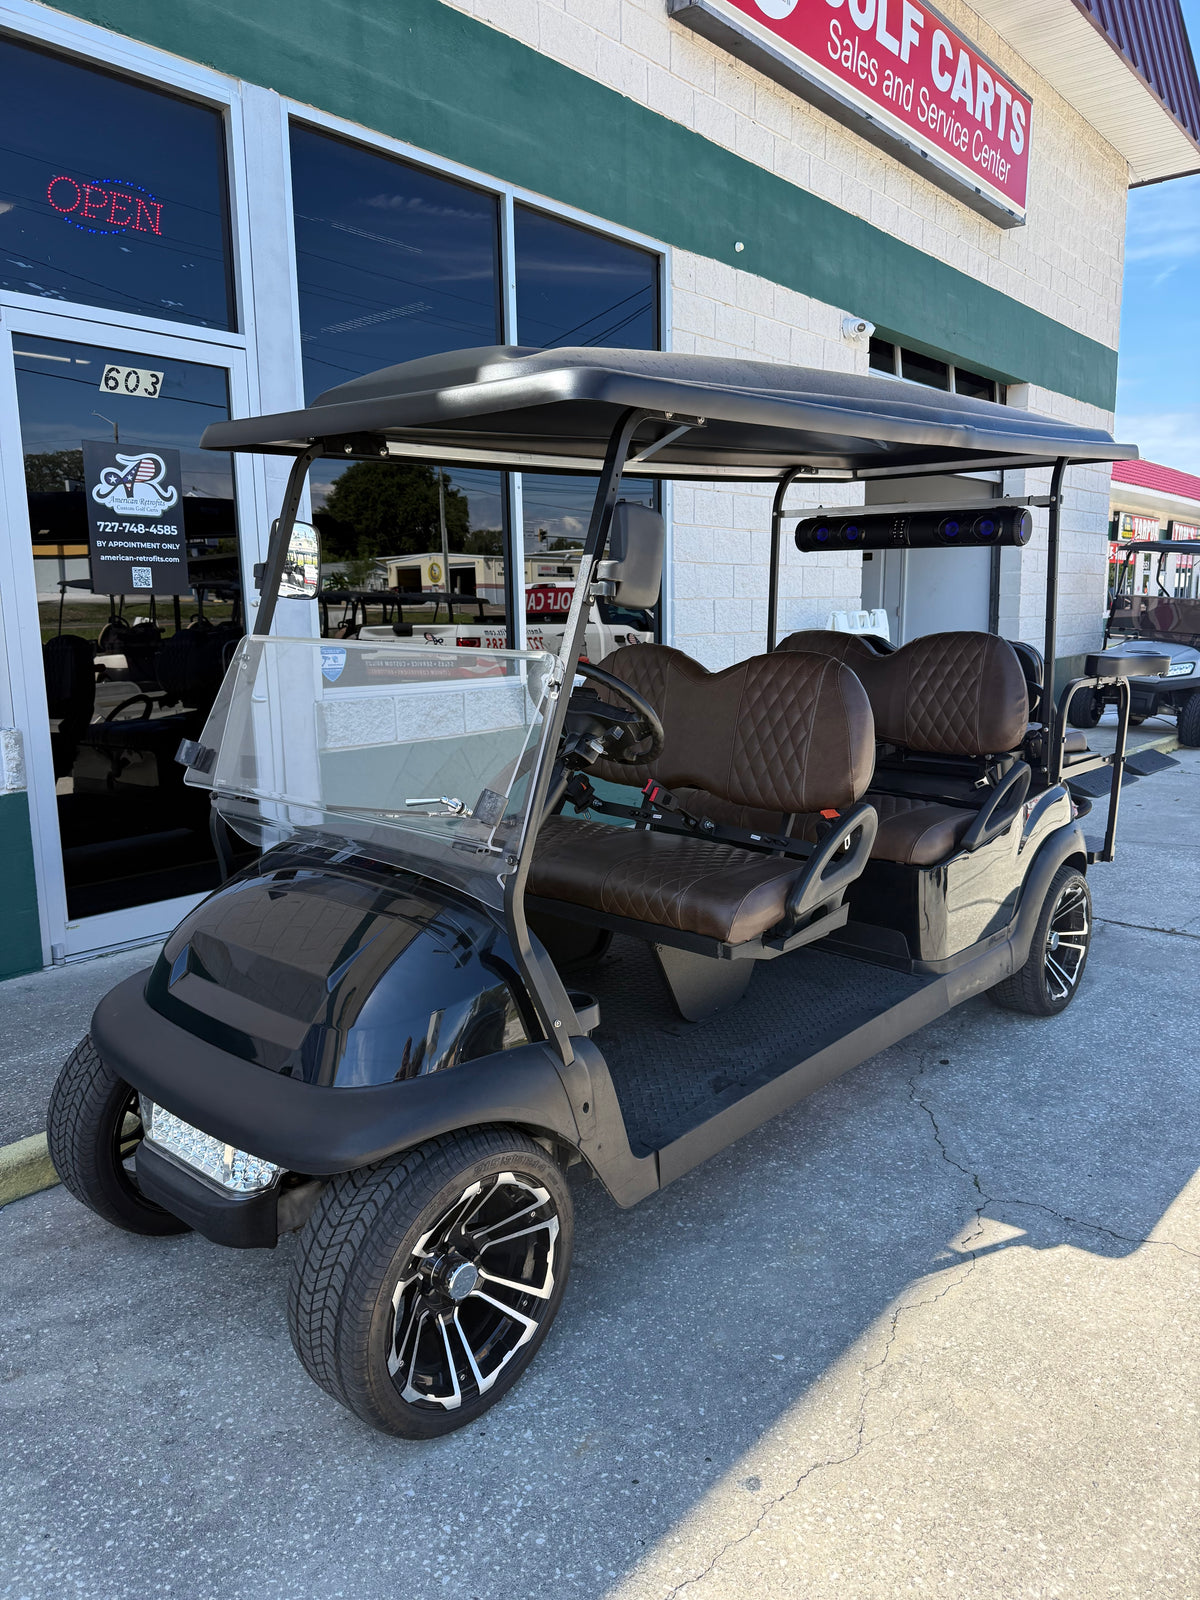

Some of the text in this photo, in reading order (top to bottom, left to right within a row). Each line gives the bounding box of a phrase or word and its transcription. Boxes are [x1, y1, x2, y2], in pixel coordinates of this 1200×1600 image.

[825, 0, 1026, 155] LF CARTS
[828, 19, 1011, 184] Sales and Service Center
[48, 176, 163, 235] OPEN
[104, 367, 160, 397] 603
[108, 496, 166, 508] American Retrofits
[97, 521, 178, 535] 727-748-4585
[108, 541, 161, 549] APPOINTMENT
[100, 554, 180, 563] american-retrofits.com
